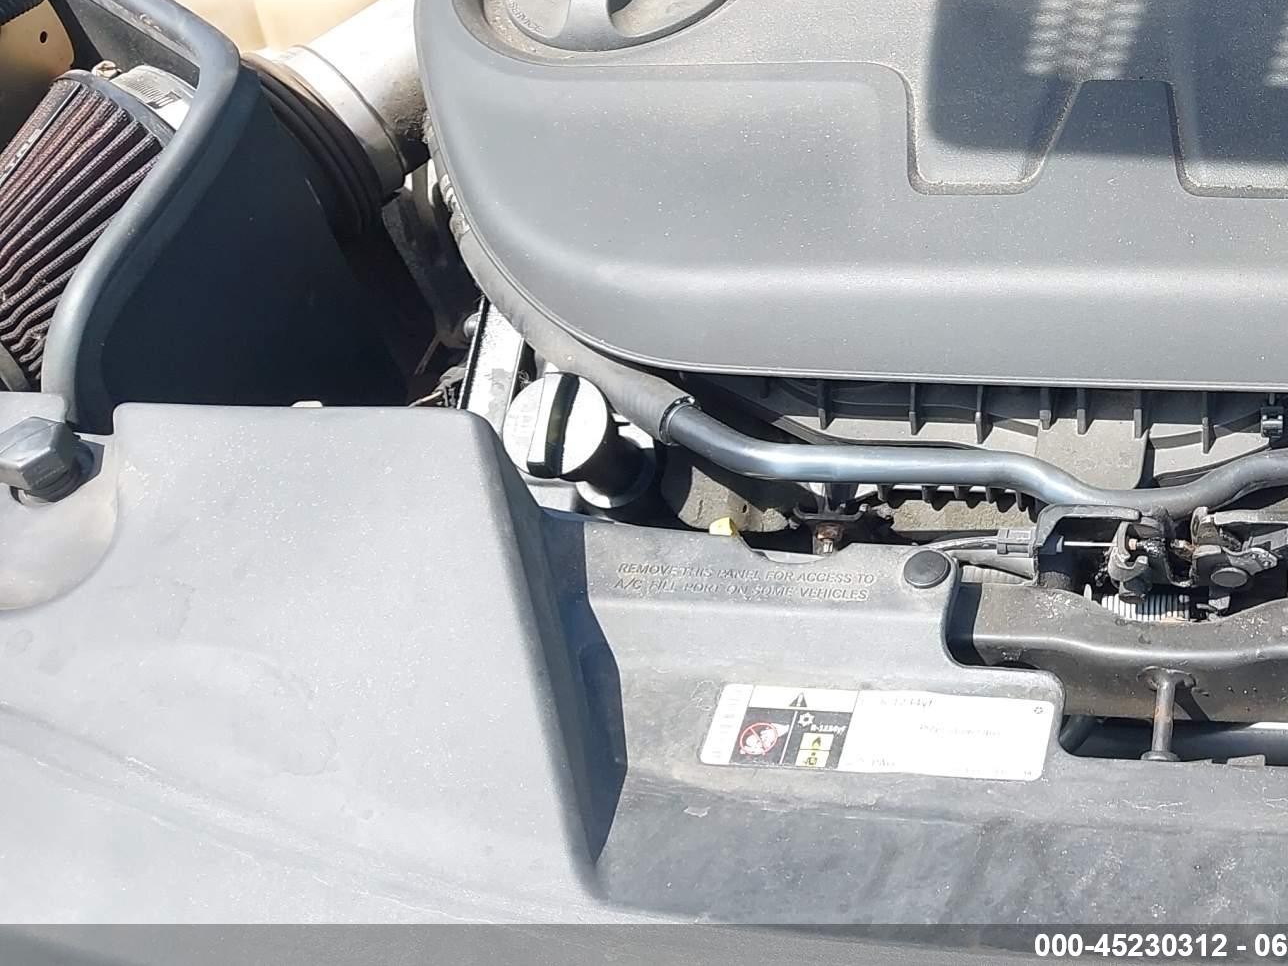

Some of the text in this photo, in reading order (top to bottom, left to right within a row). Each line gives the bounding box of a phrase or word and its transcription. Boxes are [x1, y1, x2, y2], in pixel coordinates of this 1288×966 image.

[618, 562, 875, 585] REMOVE THIS PANEL FOR ACCESS TO
[614, 578, 869, 600] A/C FILL PORT ON SOME VEHICLES
